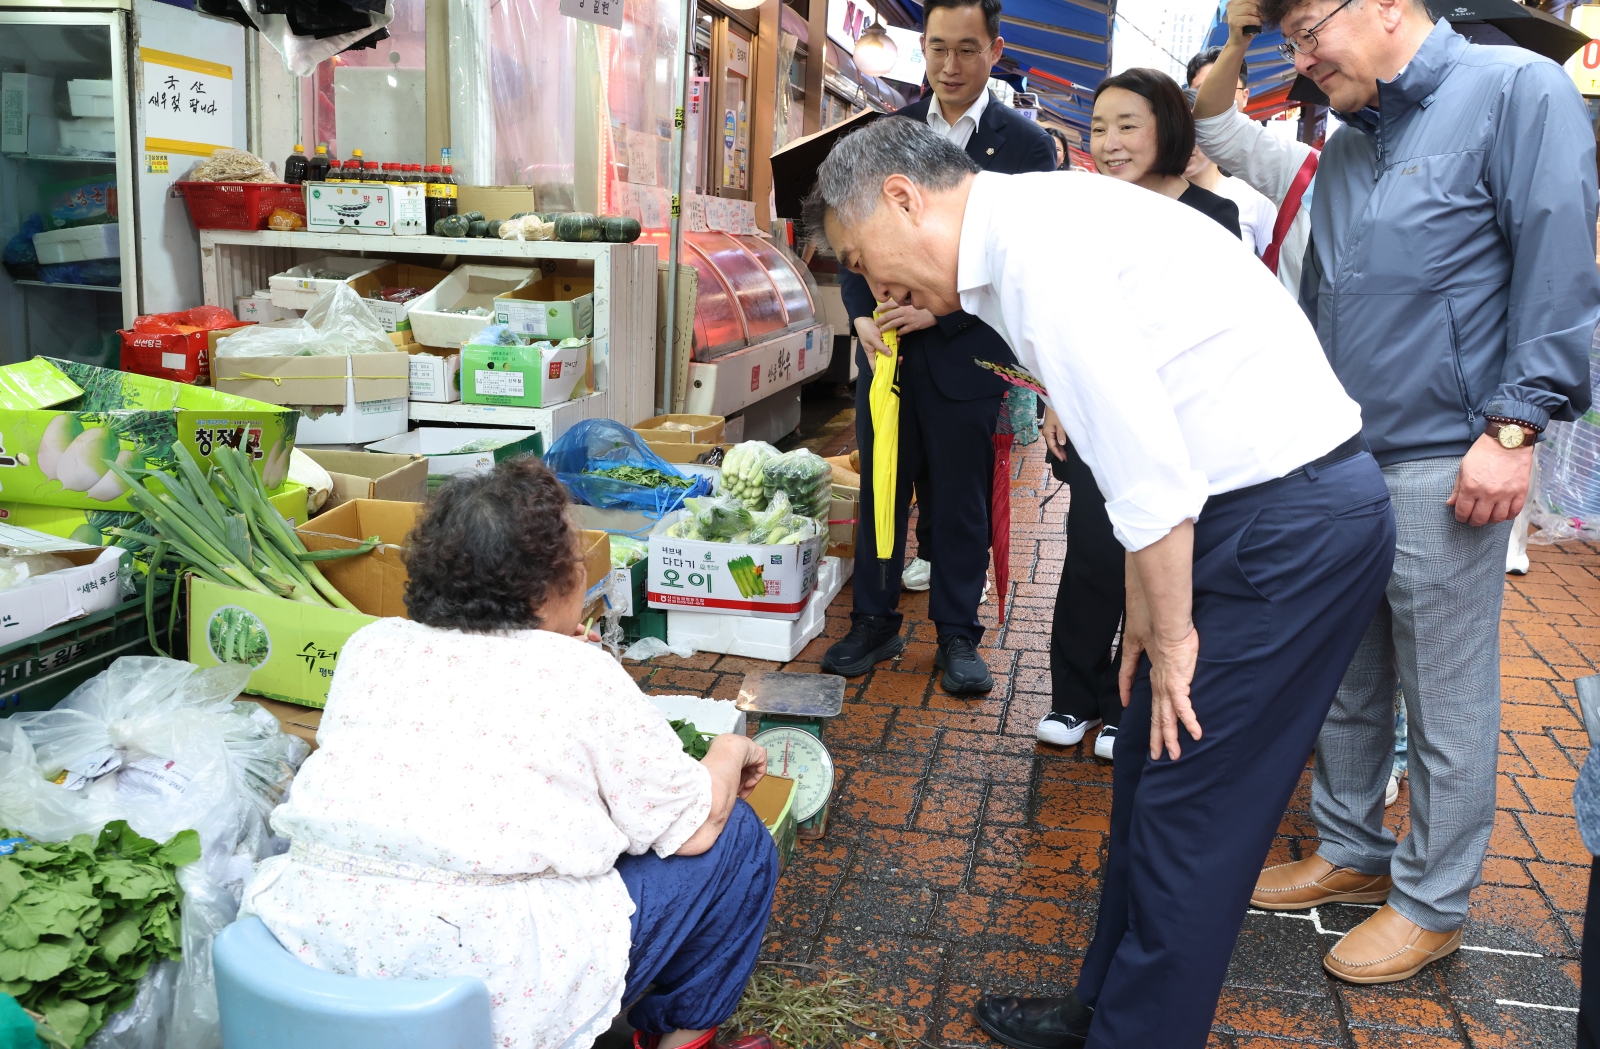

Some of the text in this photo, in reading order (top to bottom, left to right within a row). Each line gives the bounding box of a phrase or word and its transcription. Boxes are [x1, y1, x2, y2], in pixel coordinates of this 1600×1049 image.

[662, 556, 695, 569] 다다기
[99, 575, 108, 587] 후
[660, 568, 712, 594] 오이
[295, 641, 338, 674] 슈퍼
